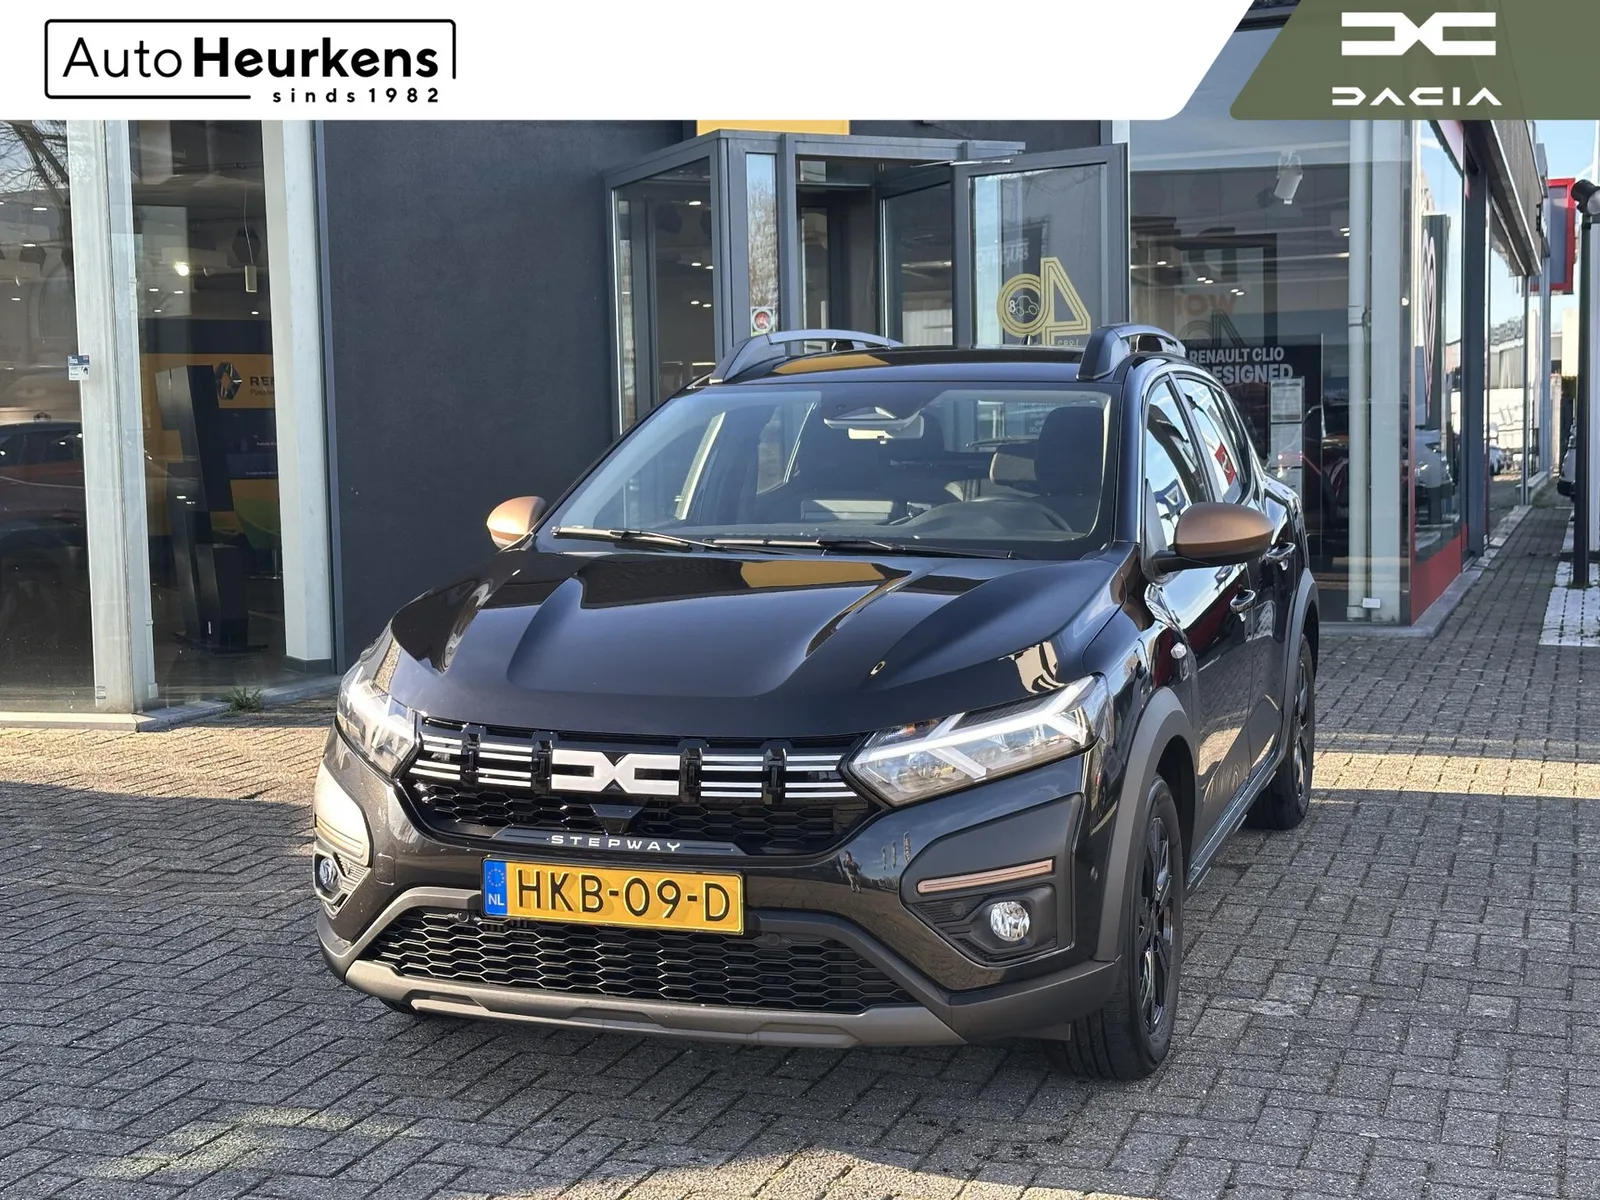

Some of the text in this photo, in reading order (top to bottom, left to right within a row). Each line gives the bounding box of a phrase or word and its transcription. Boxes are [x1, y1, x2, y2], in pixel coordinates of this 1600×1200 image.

[1188, 346, 1285, 364] RENAULT CLIO
[1204, 363, 1294, 385] ESIGNED
[550, 834, 681, 852] STEPWAY
[487, 867, 732, 923] NL HKB-09-D
